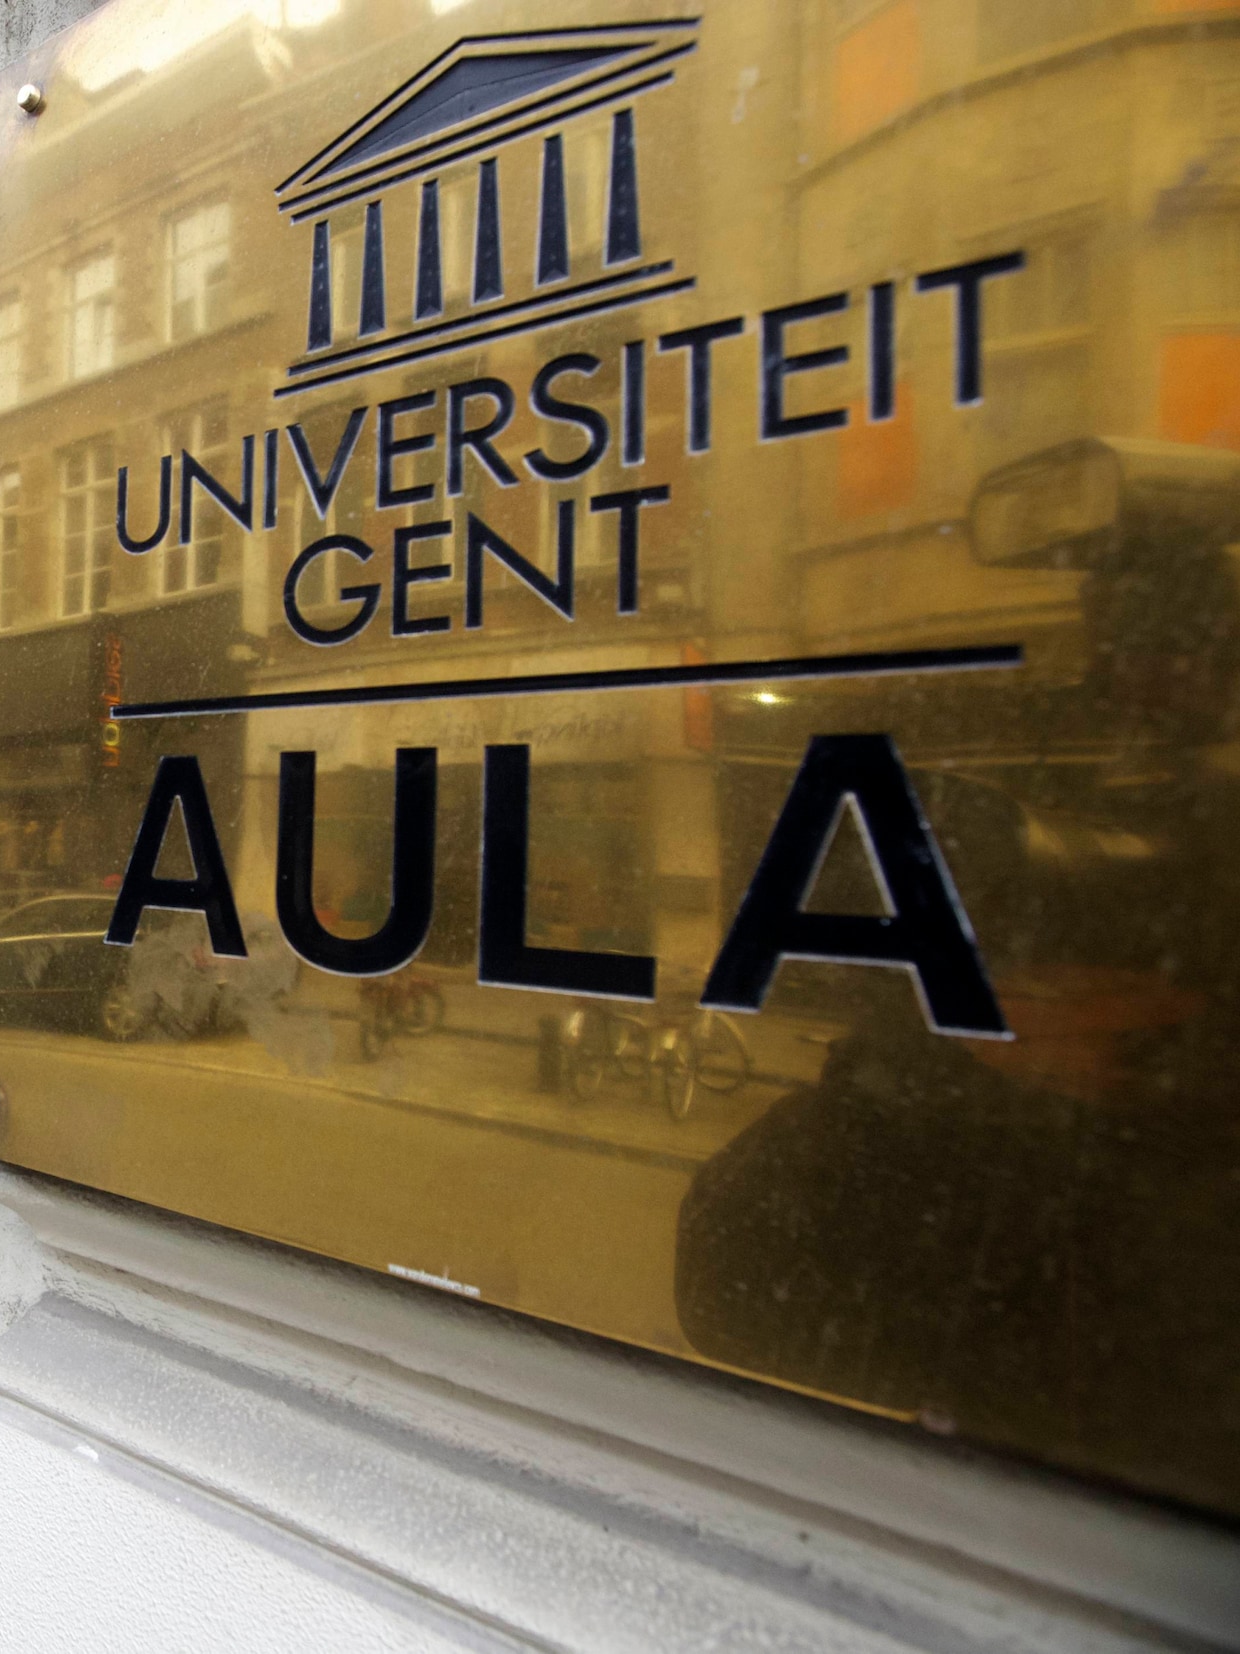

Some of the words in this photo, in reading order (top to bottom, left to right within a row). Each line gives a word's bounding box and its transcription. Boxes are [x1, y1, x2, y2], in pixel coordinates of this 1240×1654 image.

[115, 249, 1028, 555] UNIVERSITEIT
[281, 483, 671, 648] GENT
[102, 732, 1016, 1042] AULA
